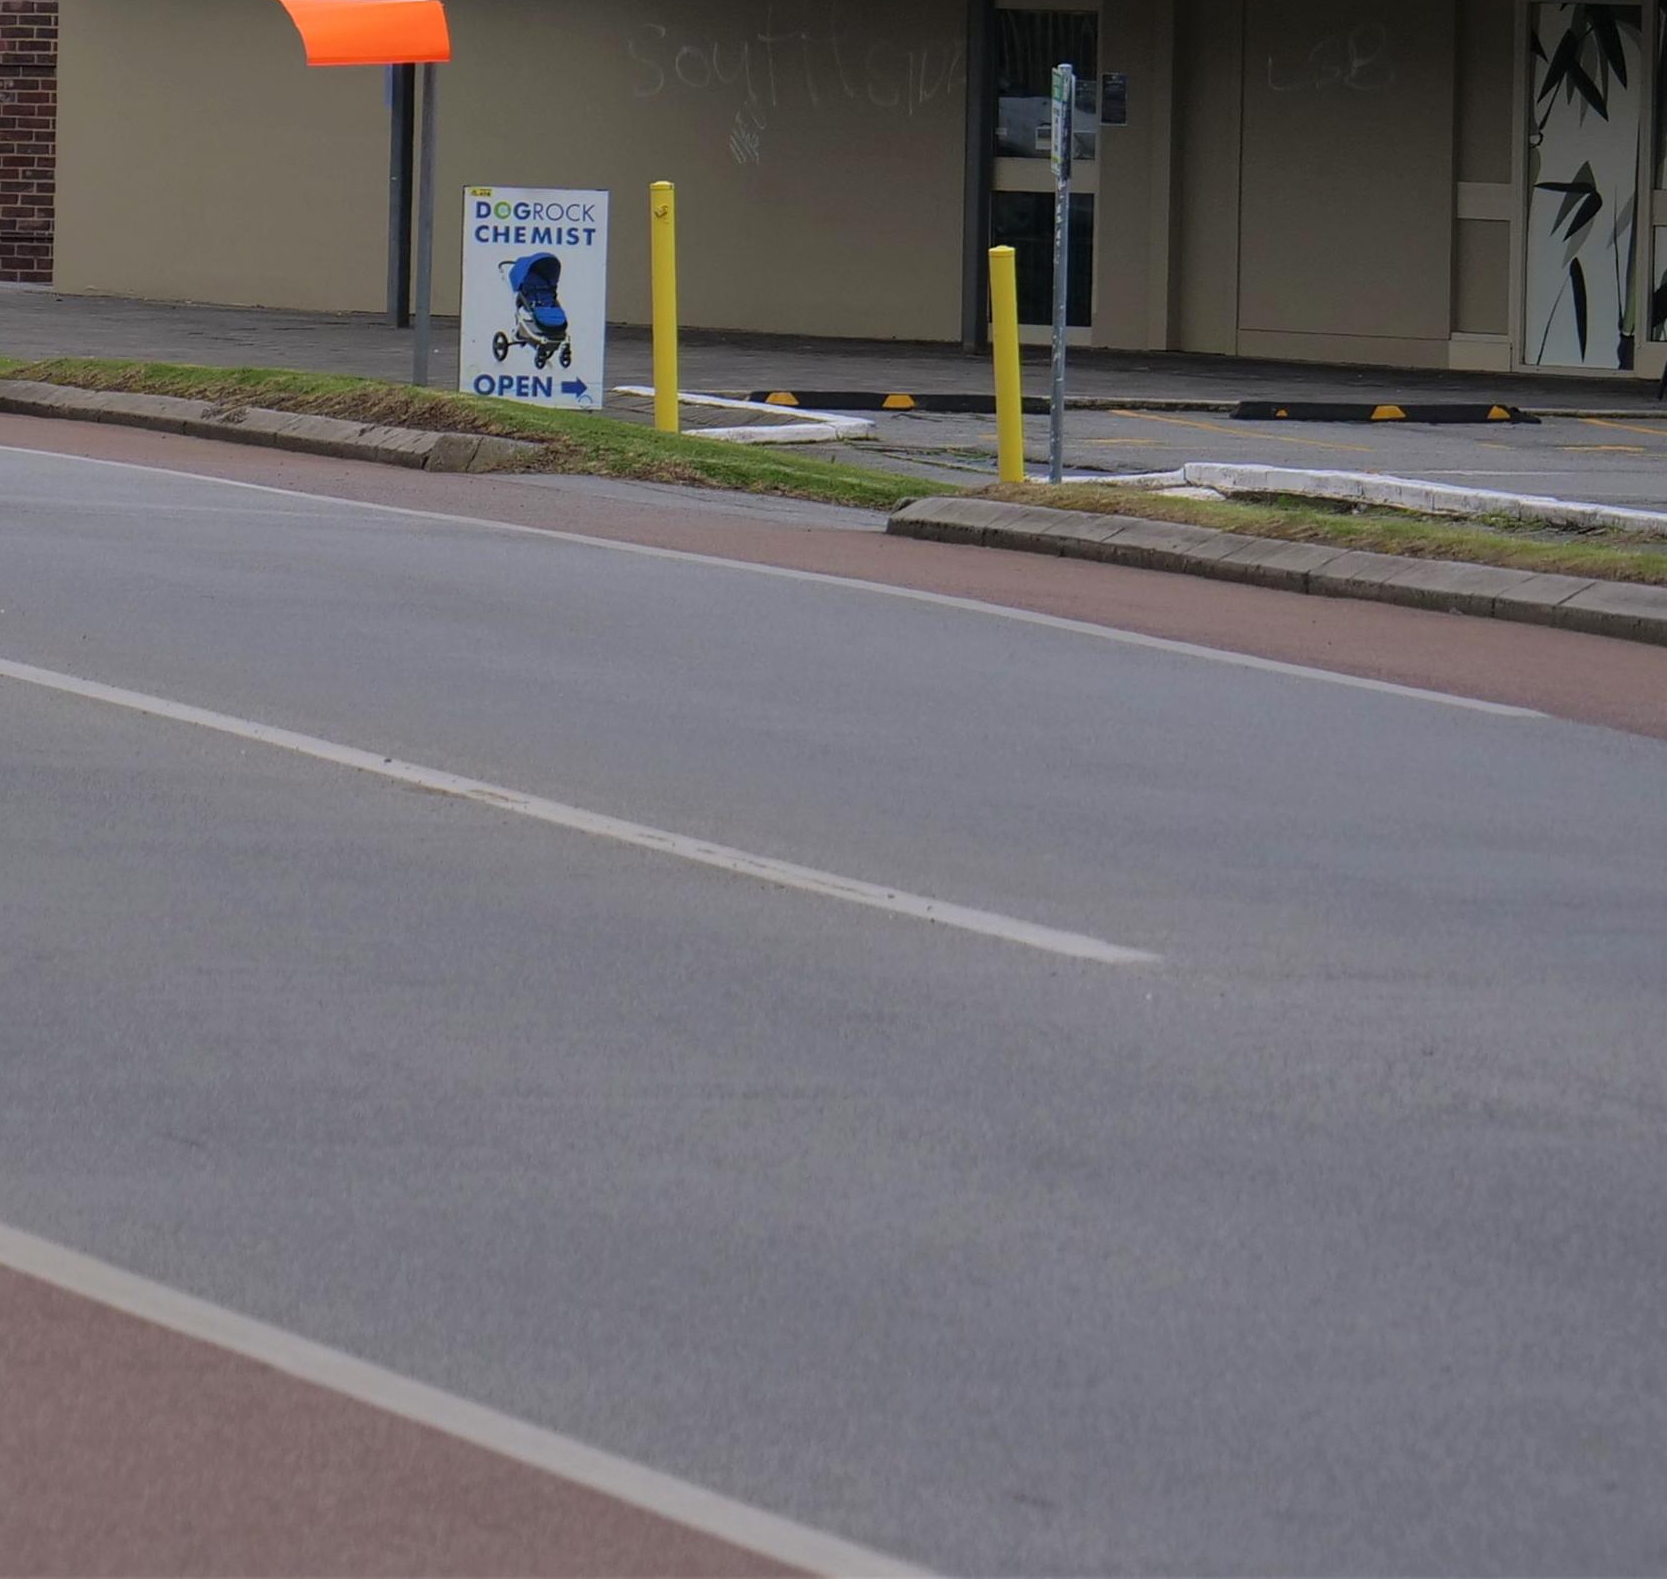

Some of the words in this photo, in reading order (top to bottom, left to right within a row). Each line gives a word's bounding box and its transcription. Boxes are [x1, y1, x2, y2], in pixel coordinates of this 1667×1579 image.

[475, 201, 596, 223] DOGROCK
[474, 224, 596, 246] CHEMIST
[473, 373, 553, 398] OPEN
